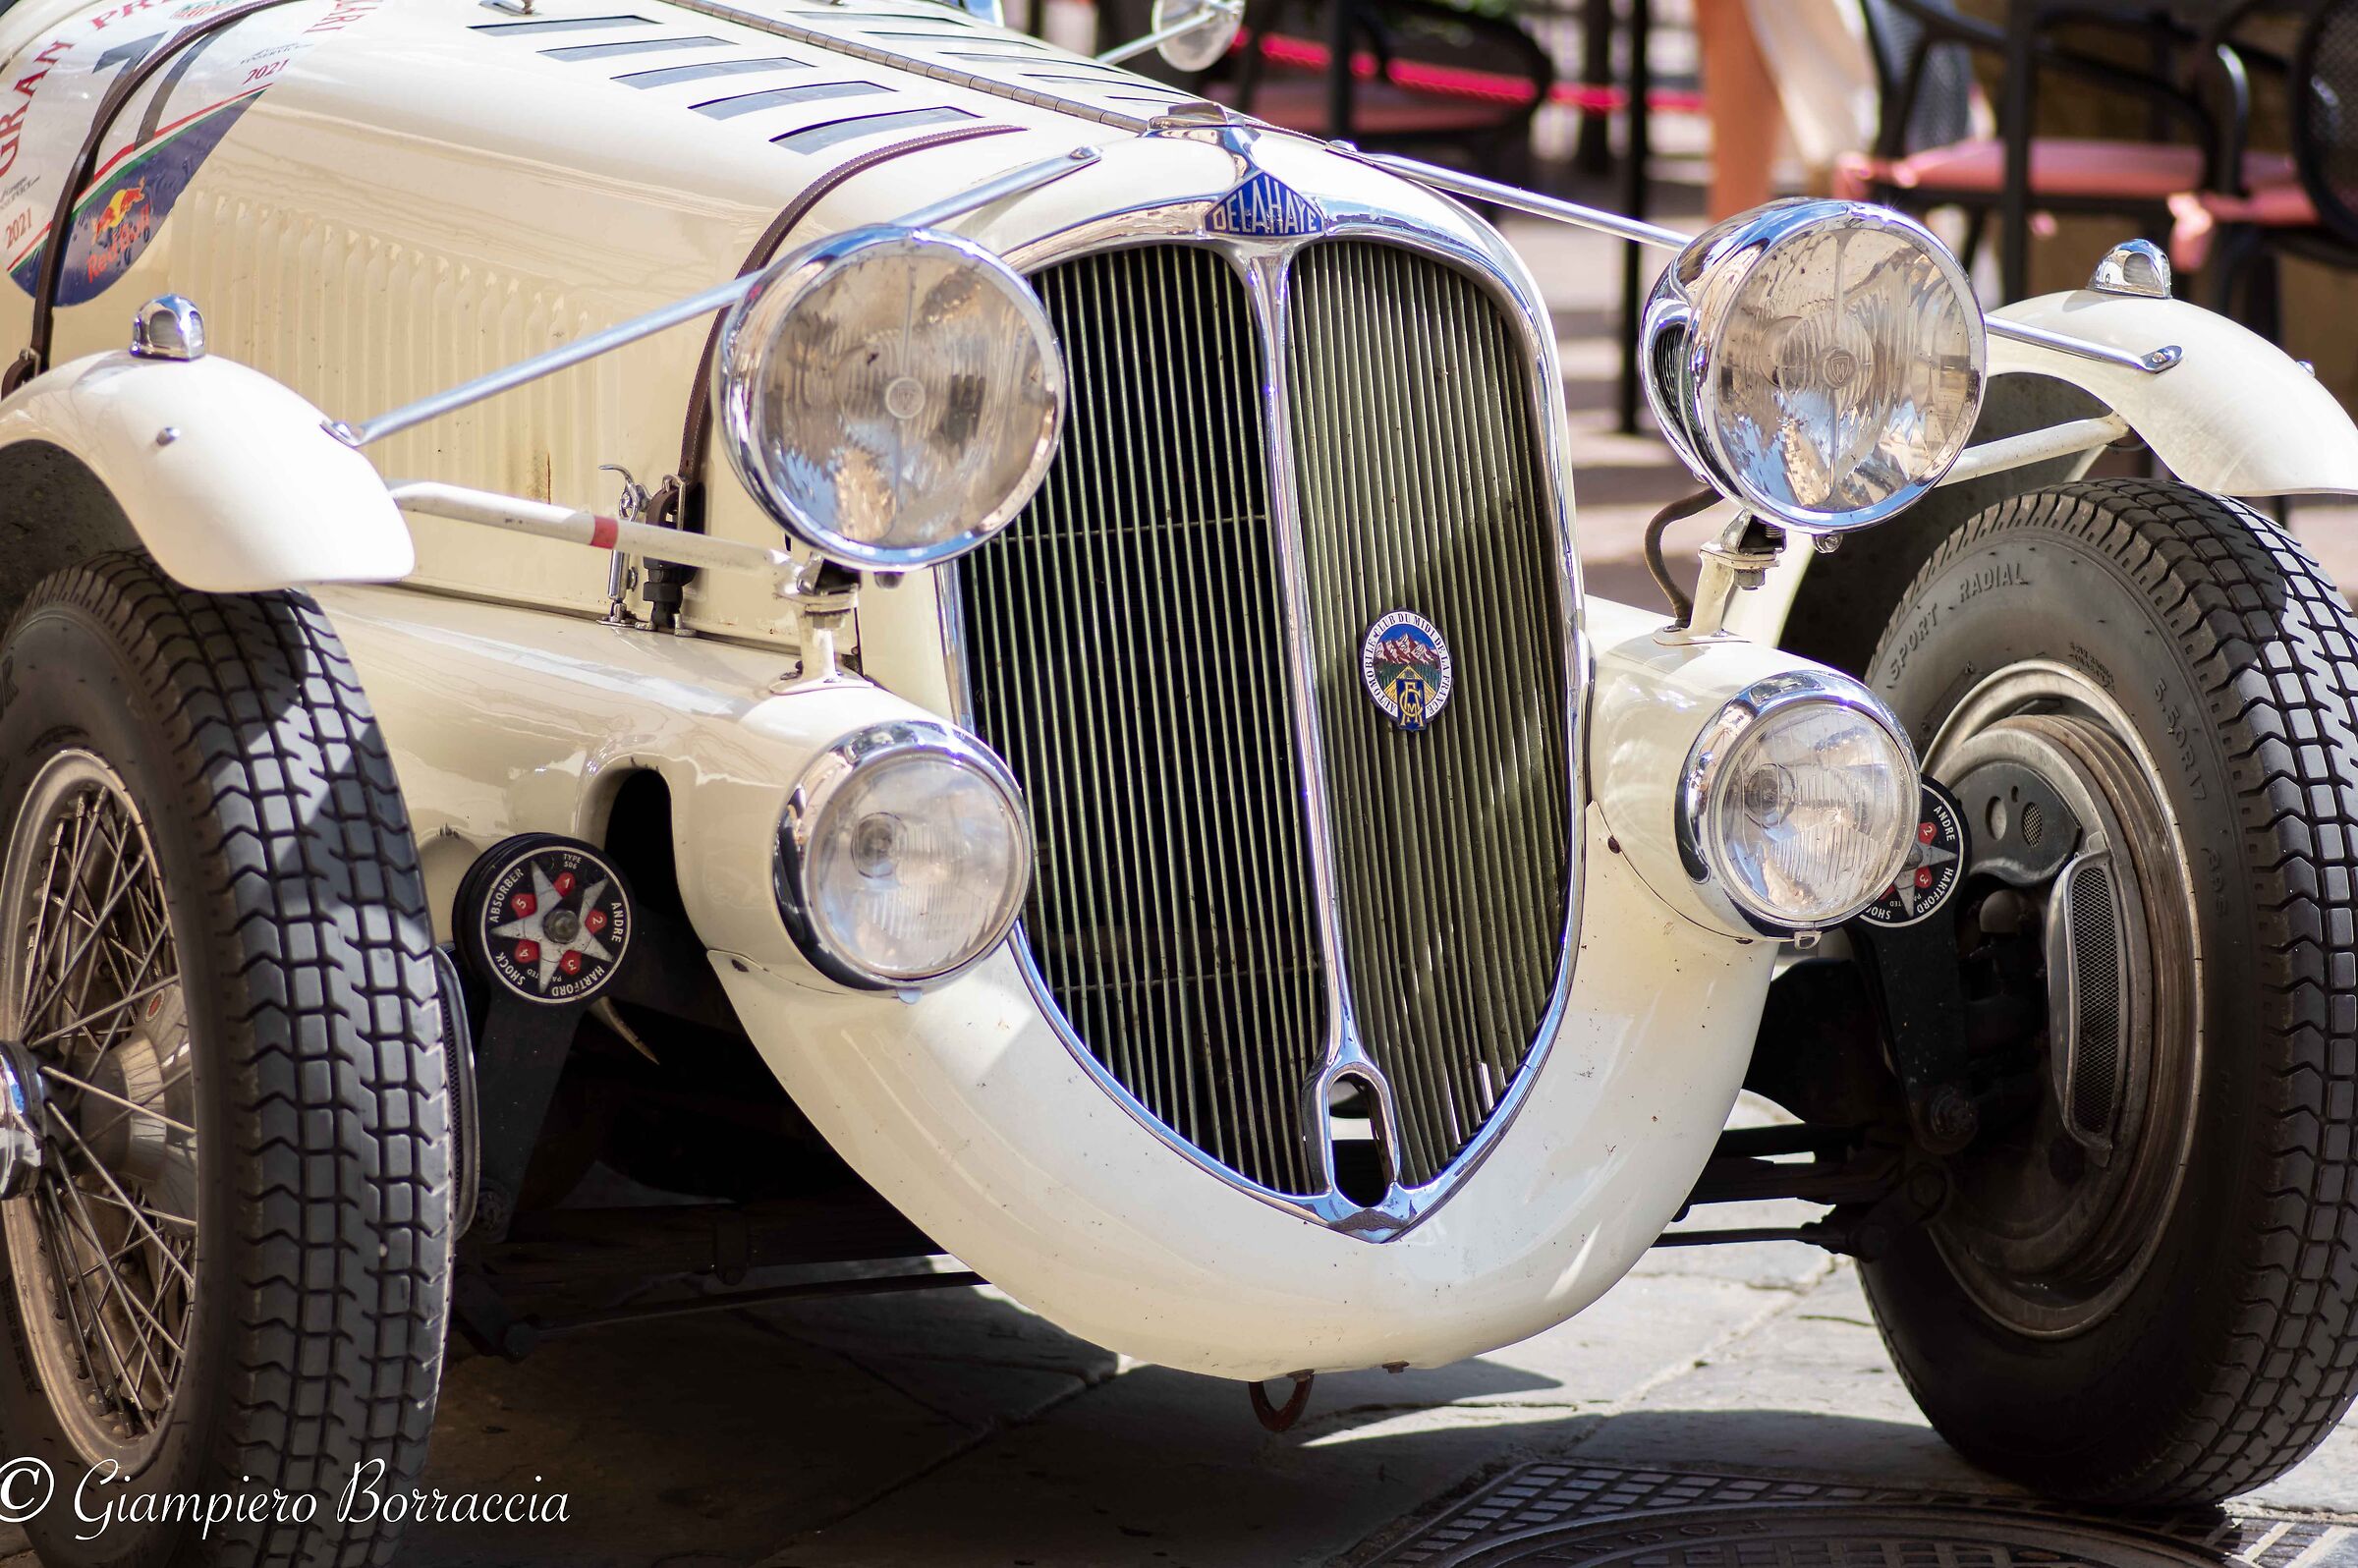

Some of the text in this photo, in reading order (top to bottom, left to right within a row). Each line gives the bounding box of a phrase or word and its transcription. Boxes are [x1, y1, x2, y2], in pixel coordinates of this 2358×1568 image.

[242, 58, 290, 85] 2021
[1211, 175, 1318, 235] DELAHAYE
[6, 204, 32, 250] 2021
[87, 231, 119, 284] Red
[1889, 562, 2026, 681] SPORT RADIAL
[1365, 613, 1450, 714] AUTOMOBILE CLUB DU MIDI DE LA FRANCE
[1923, 826, 1933, 836] 2
[563, 854, 582, 864] TYPE
[1866, 805, 1955, 920] ANDRE HARTFORD SHO
[564, 877, 571, 888] 1
[1919, 873, 1930, 884] 3
[517, 899, 527, 910] 5
[489, 868, 624, 996] ANDRE HARTFORD SHOCK ABSORBER
[592, 916, 603, 924] 2
[567, 959, 577, 971] 3
